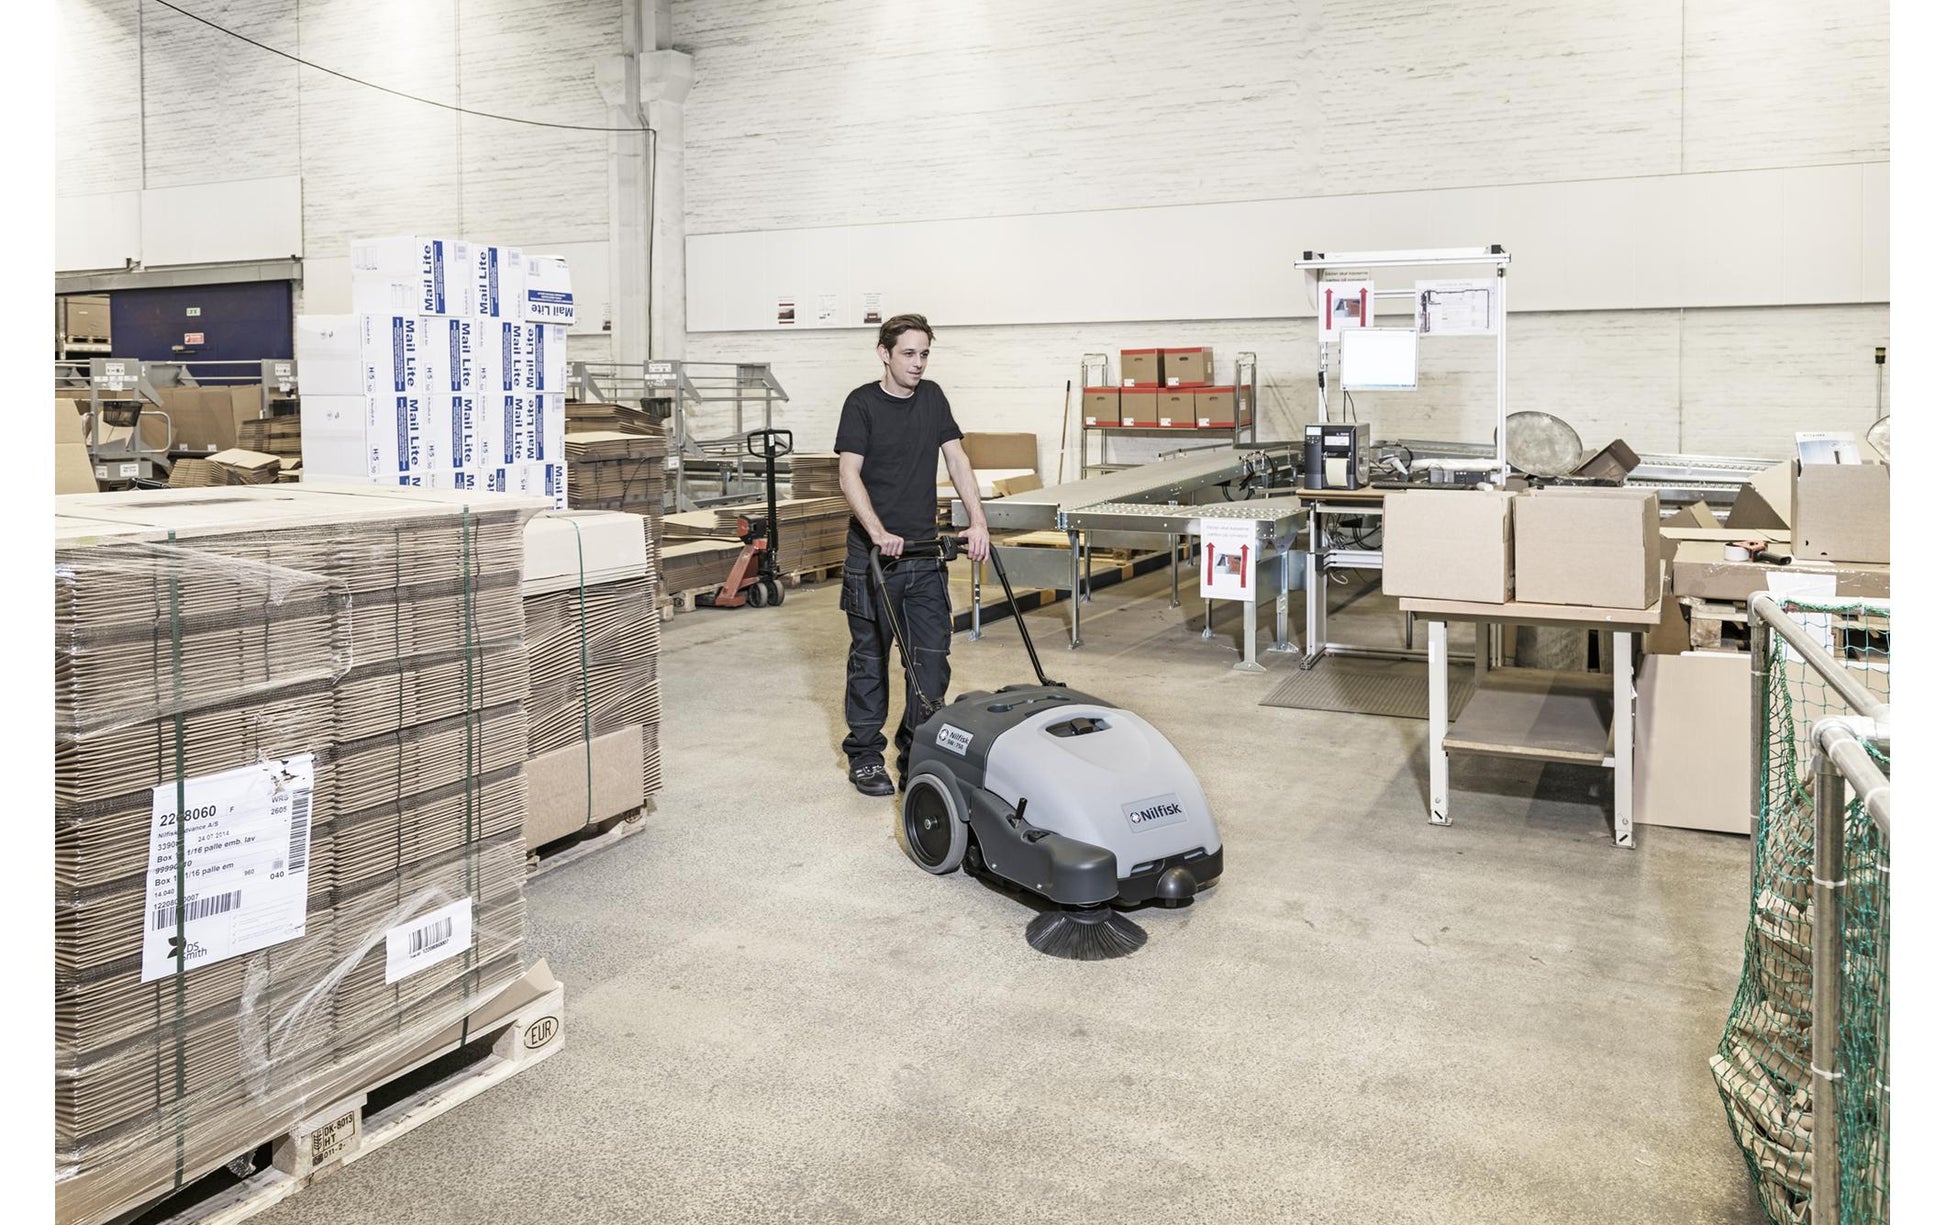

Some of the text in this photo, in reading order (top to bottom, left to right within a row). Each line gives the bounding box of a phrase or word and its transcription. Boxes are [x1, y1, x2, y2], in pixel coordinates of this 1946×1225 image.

[423, 245, 432, 274] Lite
[479, 252, 487, 279] Lite
[424, 280, 433, 310] Mail
[479, 284, 488, 314] Mail
[531, 304, 573, 317] Mail Lite
[513, 326, 521, 354] Mail
[405, 320, 416, 387] Mail Lite
[462, 323, 471, 386] Mail Lite
[526, 328, 534, 388] Mail Lite
[409, 400, 420, 465] Mail Lite
[464, 400, 473, 462] Mail Lite
[487, 474, 495, 491] ite
[950, 732, 969, 744] Nilfisk
[160, 805, 217, 826] 228060
[271, 806, 287, 815] 2605
[1141, 803, 1182, 821] Nilfisk
[157, 855, 172, 863] Box
[187, 847, 202, 856] 1/16
[204, 843, 222, 854] palle
[155, 878, 170, 886] Box
[185, 869, 200, 879] 1/16
[202, 866, 220, 877] palle
[270, 871, 284, 879] 040
[183, 948, 207, 961] Smith
[187, 942, 199, 953] DS
[532, 1020, 551, 1045] EUR
[325, 1134, 336, 1146] HT
